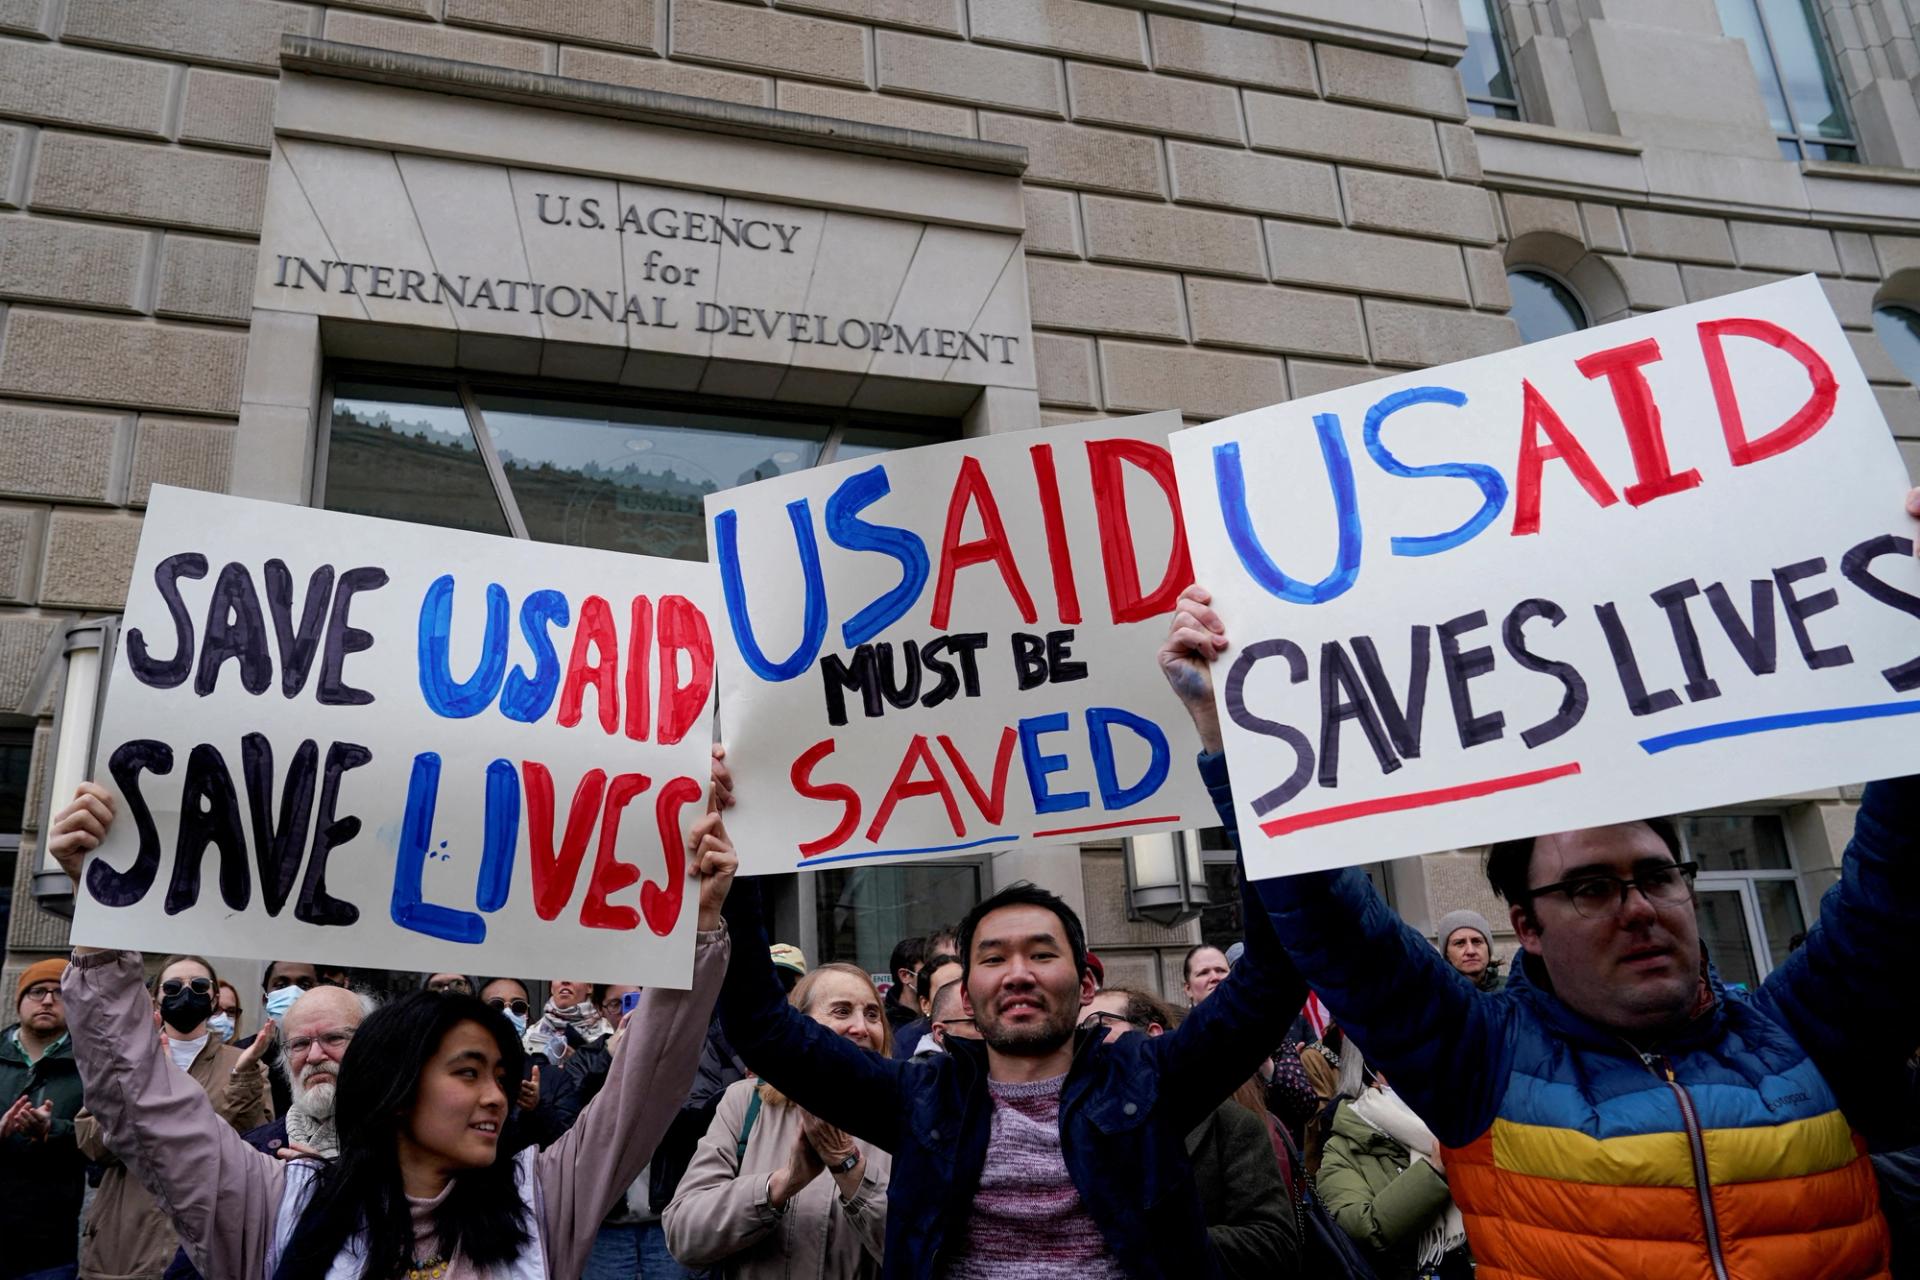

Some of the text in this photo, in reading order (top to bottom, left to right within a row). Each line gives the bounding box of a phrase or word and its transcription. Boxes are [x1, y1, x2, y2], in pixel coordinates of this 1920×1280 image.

[274, 254, 1018, 363] INTERNATIONAL DEVELOPMENT
[536, 193, 801, 254] U.S. AGENCY
[643, 250, 699, 286] for
[1213, 318, 1839, 605] USAID
[714, 438, 1197, 682] USAID
[126, 551, 715, 745] SAVE USAID
[820, 628, 1088, 726] MUST BE
[1225, 534, 1920, 817] SAVES LIVES
[86, 731, 702, 945] SAVE LIVES
[790, 707, 1171, 859] SAVED
